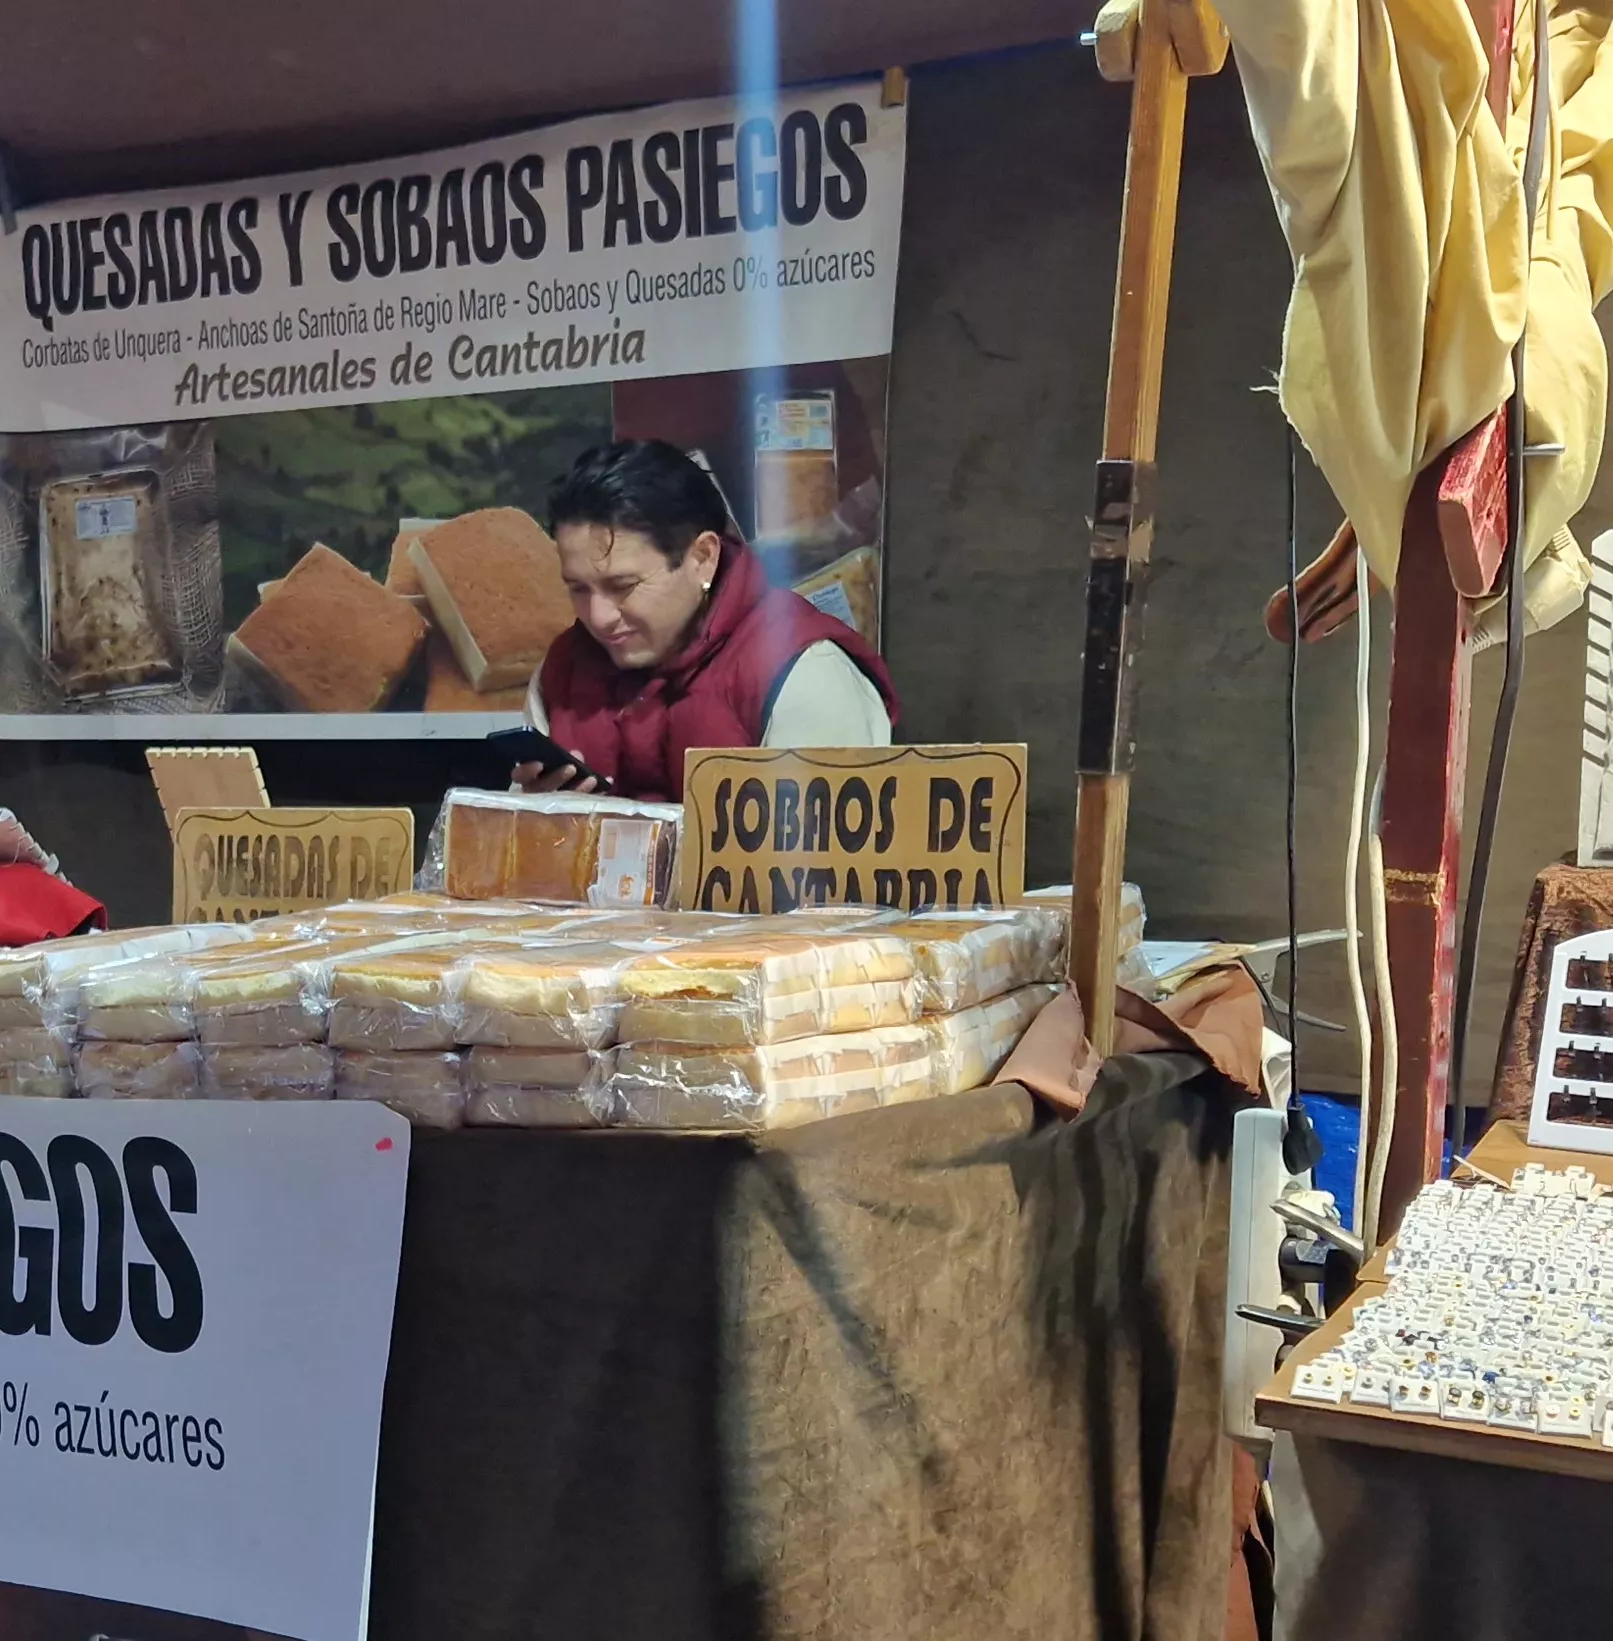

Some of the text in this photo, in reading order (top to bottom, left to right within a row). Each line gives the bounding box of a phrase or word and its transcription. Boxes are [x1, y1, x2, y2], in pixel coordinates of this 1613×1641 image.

[21, 101, 868, 333] QUESADAS Y SOBAOS PASIEGOS
[22, 336, 90, 369] Corbatas
[93, 331, 111, 362] de
[115, 327, 182, 363] Unquera
[198, 319, 269, 350] Anchoas
[273, 311, 293, 342] de
[298, 301, 369, 339] Santoña
[373, 301, 395, 332] de
[400, 293, 454, 334] Regio
[458, 288, 507, 323] Mare
[526, 278, 601, 316] Sobaos
[606, 278, 620, 315] y
[625, 262, 726, 305] Quesadas
[732, 254, 768, 293] 0%
[776, 247, 876, 288] azúcares
[173, 316, 647, 407] Artesanales de Cantabria
[710, 775, 995, 855] SOBAOS DE
[193, 833, 393, 901] QUESADAS DE
[54, 1389, 226, 1472] azúcares
